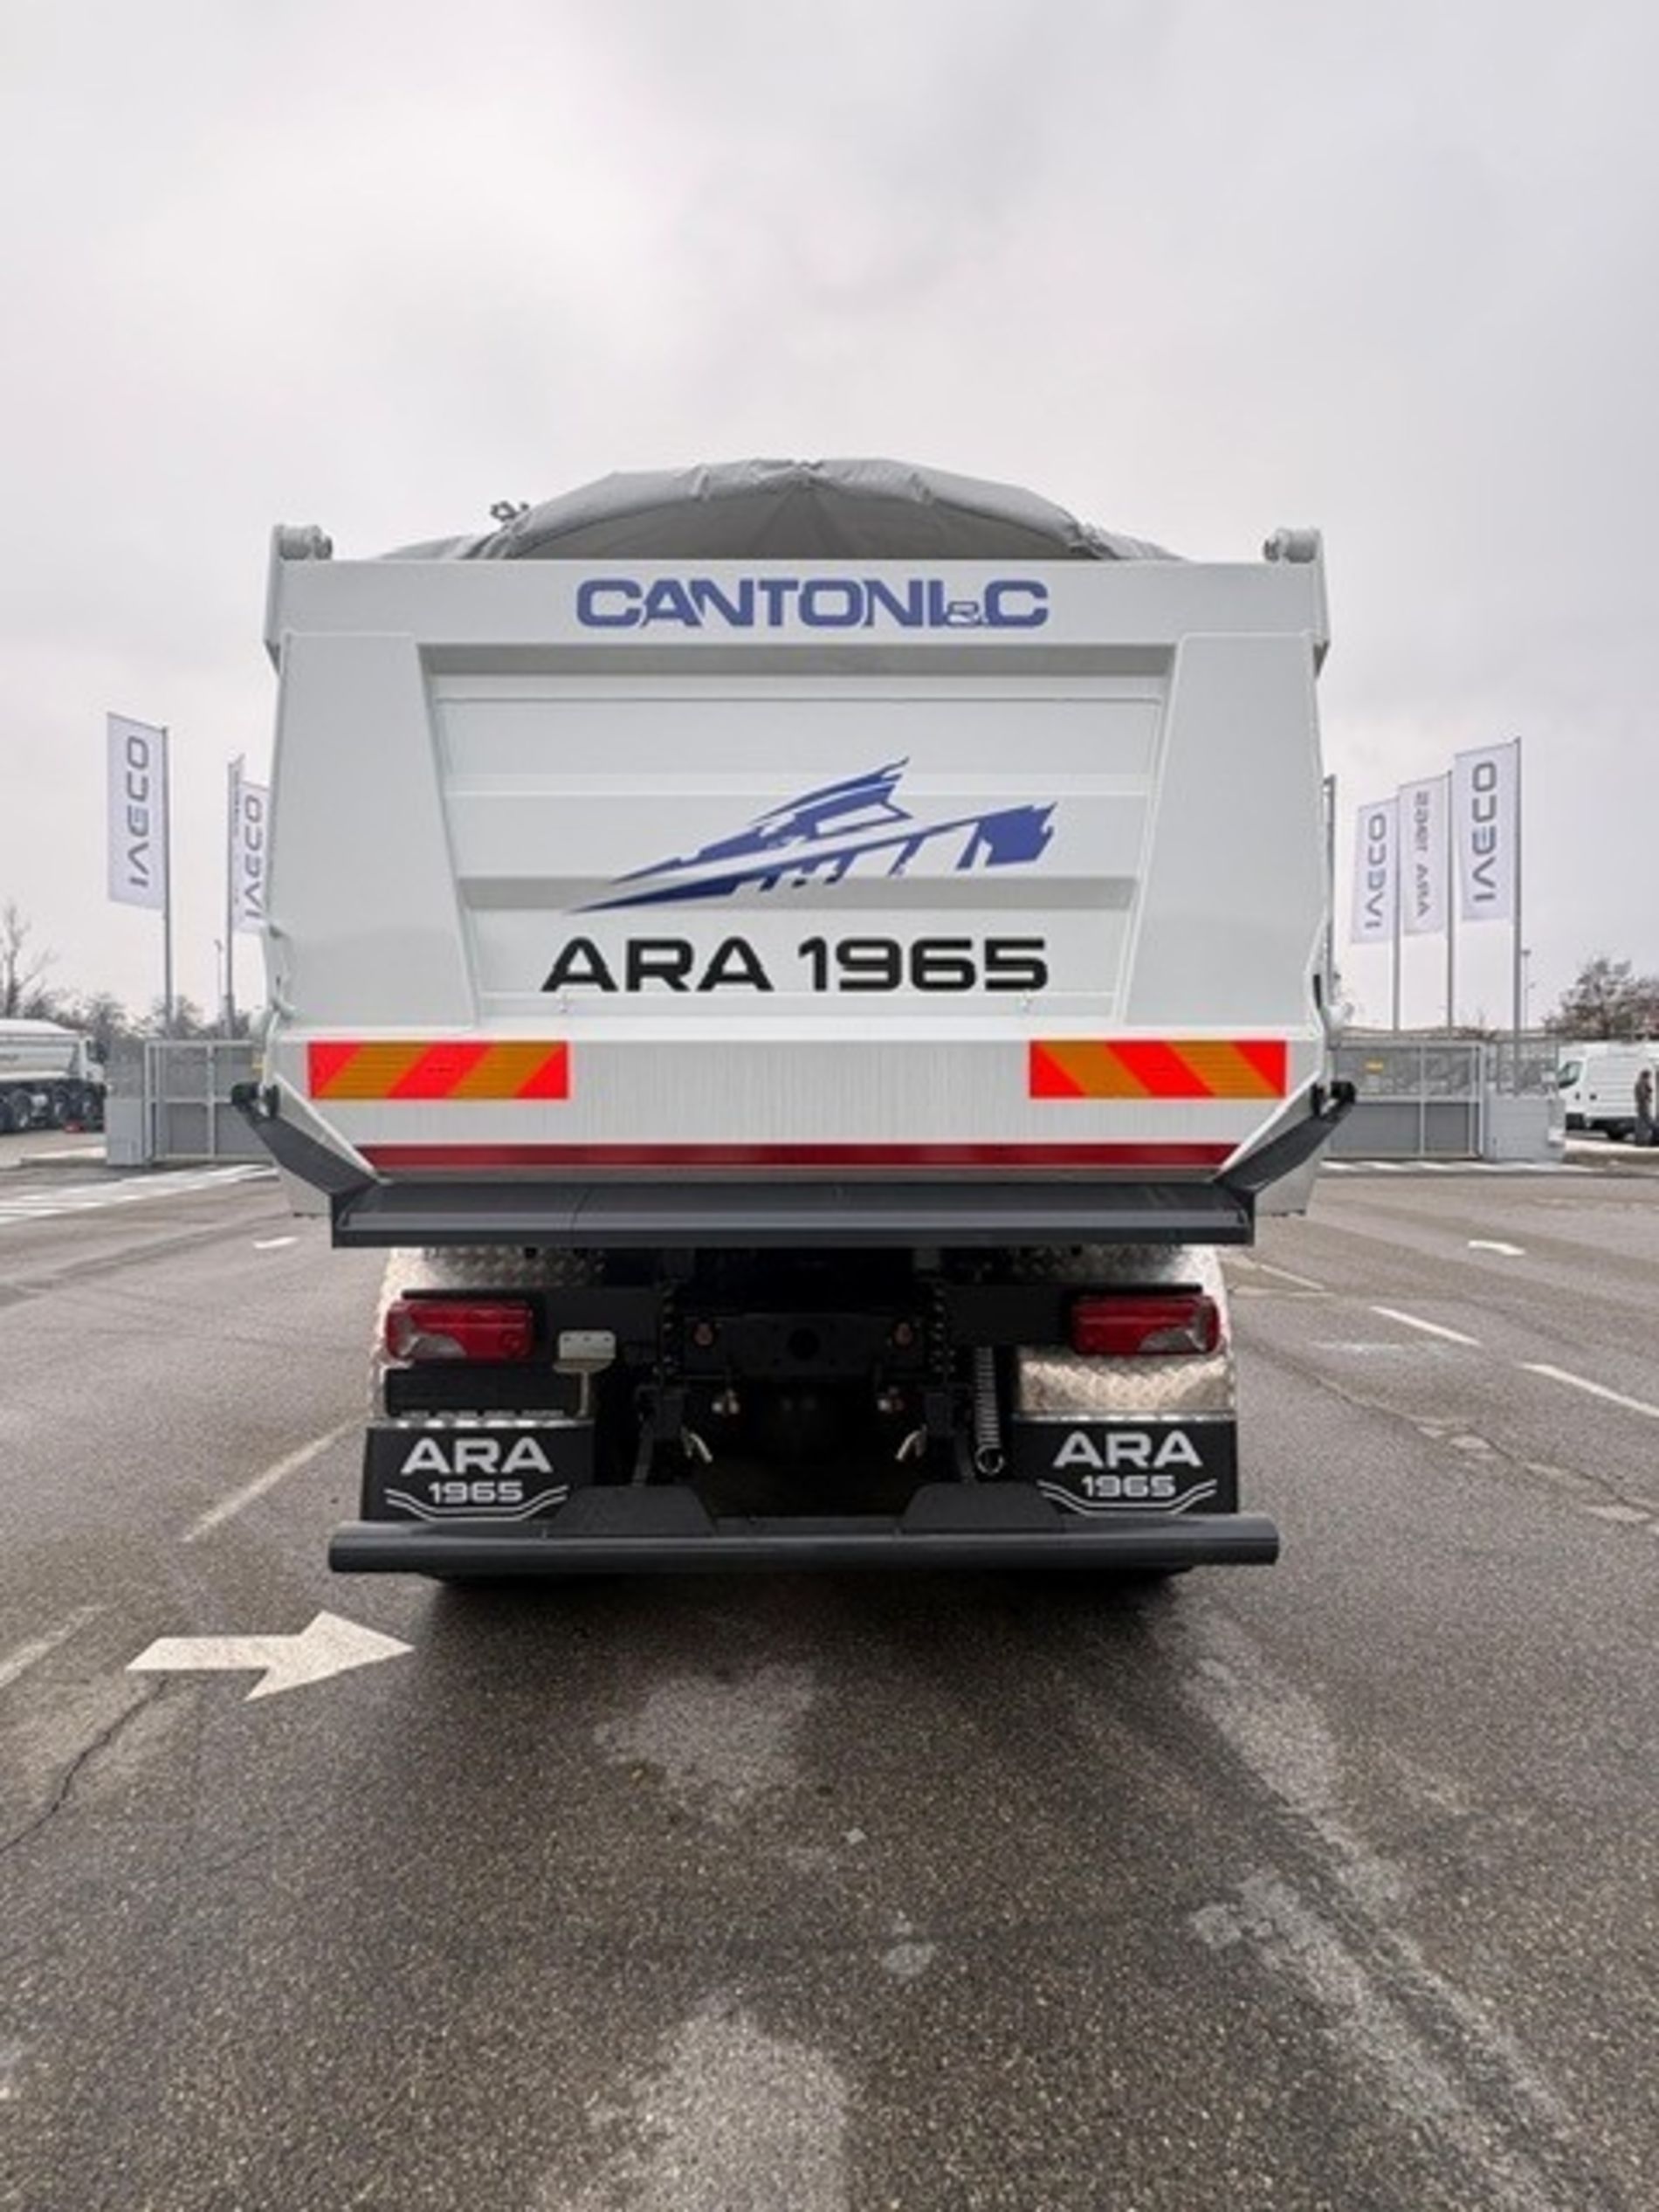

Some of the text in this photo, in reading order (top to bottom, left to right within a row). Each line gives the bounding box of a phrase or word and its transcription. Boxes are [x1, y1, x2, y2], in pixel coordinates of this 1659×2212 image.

[540, 935, 1049, 992] ARA 1965
[401, 1437, 553, 1474] ARA
[1053, 1430, 1202, 1469] ARA
[428, 1481, 524, 1505] 1965
[1080, 1475, 1177, 1499] 1965
